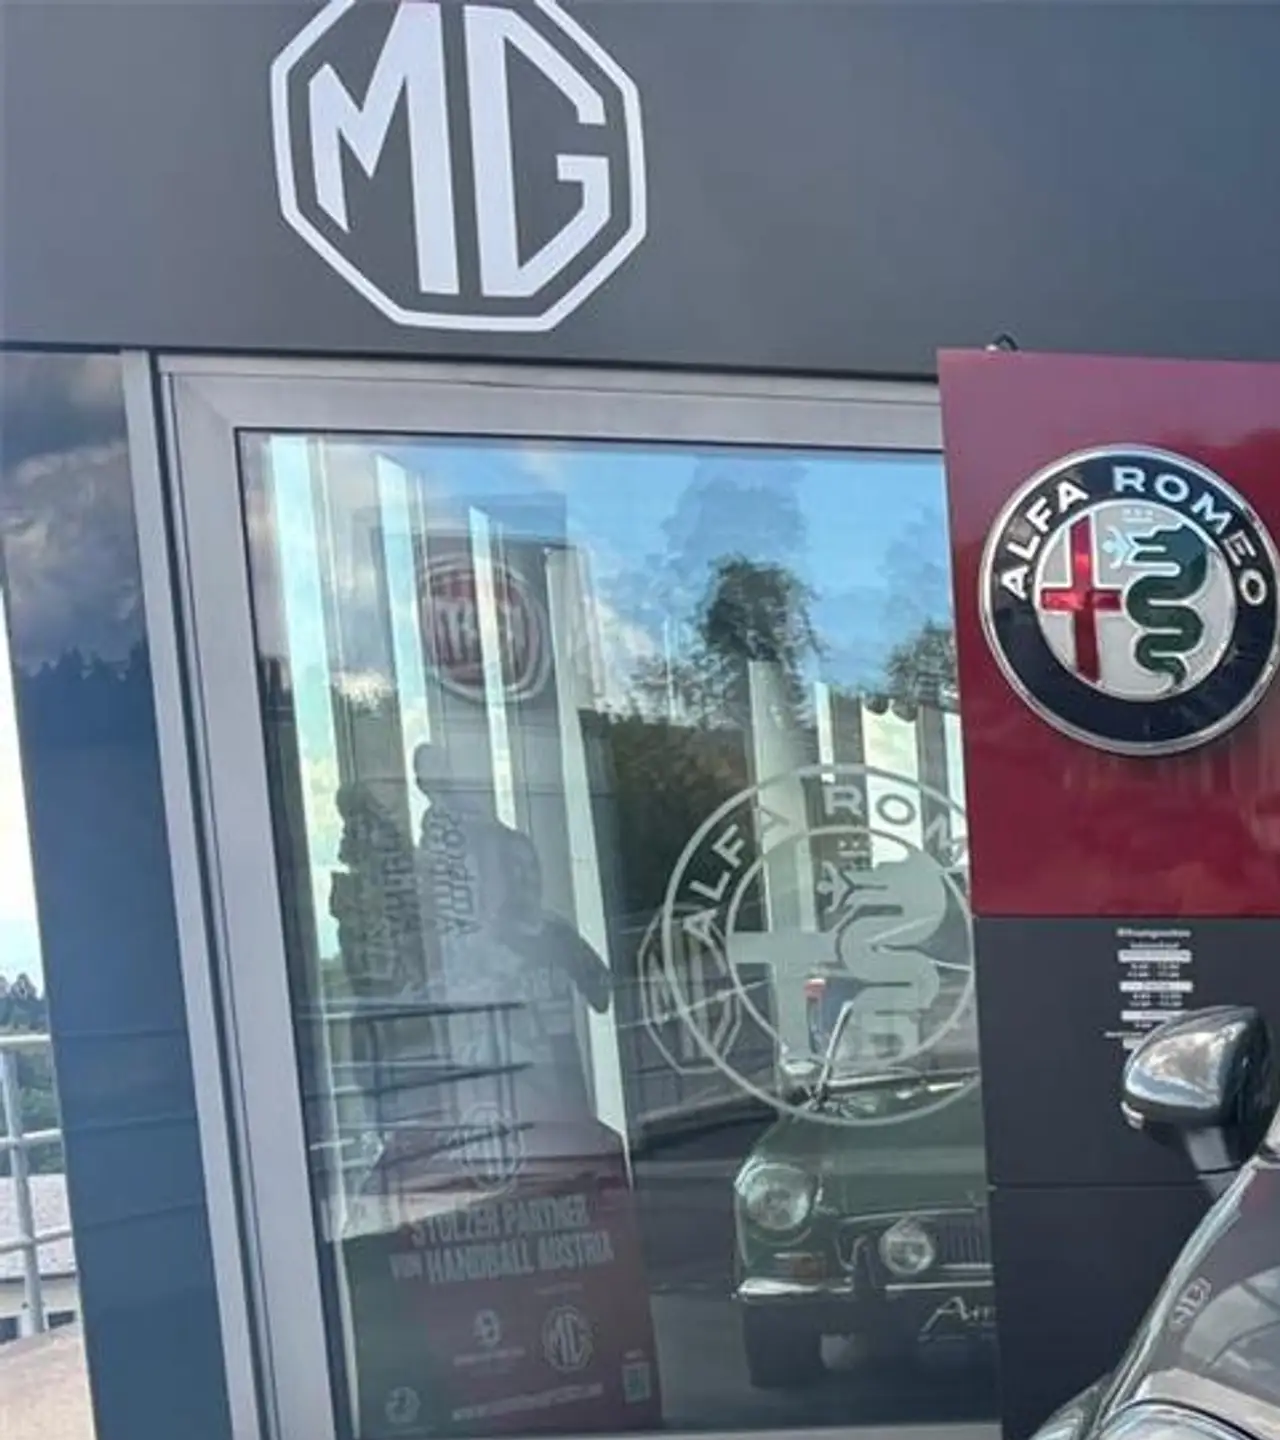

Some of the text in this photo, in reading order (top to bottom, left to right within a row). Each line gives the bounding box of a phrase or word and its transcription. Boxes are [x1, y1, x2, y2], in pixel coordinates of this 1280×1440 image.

[309, 0, 611, 298] MG
[1001, 465, 1268, 605] ALFA ROMEO
[683, 785, 968, 943] ALFA ROM
